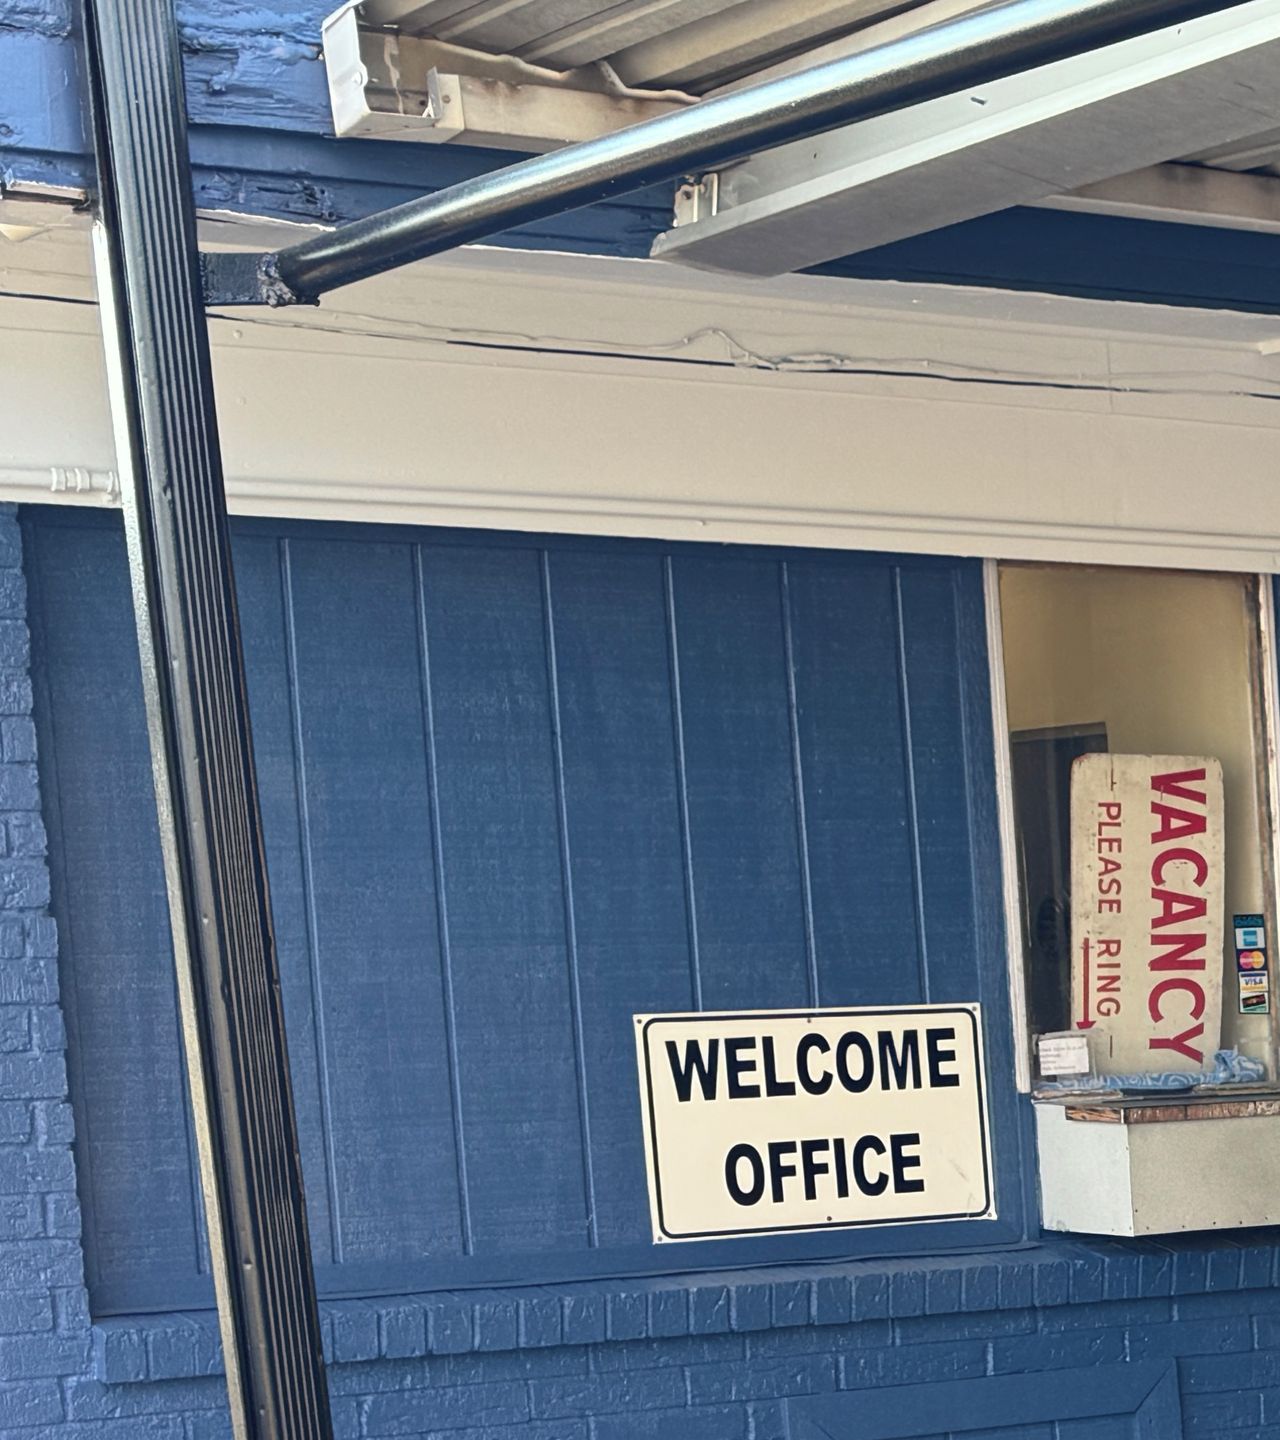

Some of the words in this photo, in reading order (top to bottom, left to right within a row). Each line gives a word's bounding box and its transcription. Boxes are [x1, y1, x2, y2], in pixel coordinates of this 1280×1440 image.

[1097, 801, 1122, 914] PLEASE
[1149, 768, 1208, 1064] VACANCY
[1096, 939, 1122, 1017] RING
[1244, 977, 1263, 986] VISA
[665, 1028, 960, 1102] WELCOME
[725, 1133, 925, 1206] OFFICE
